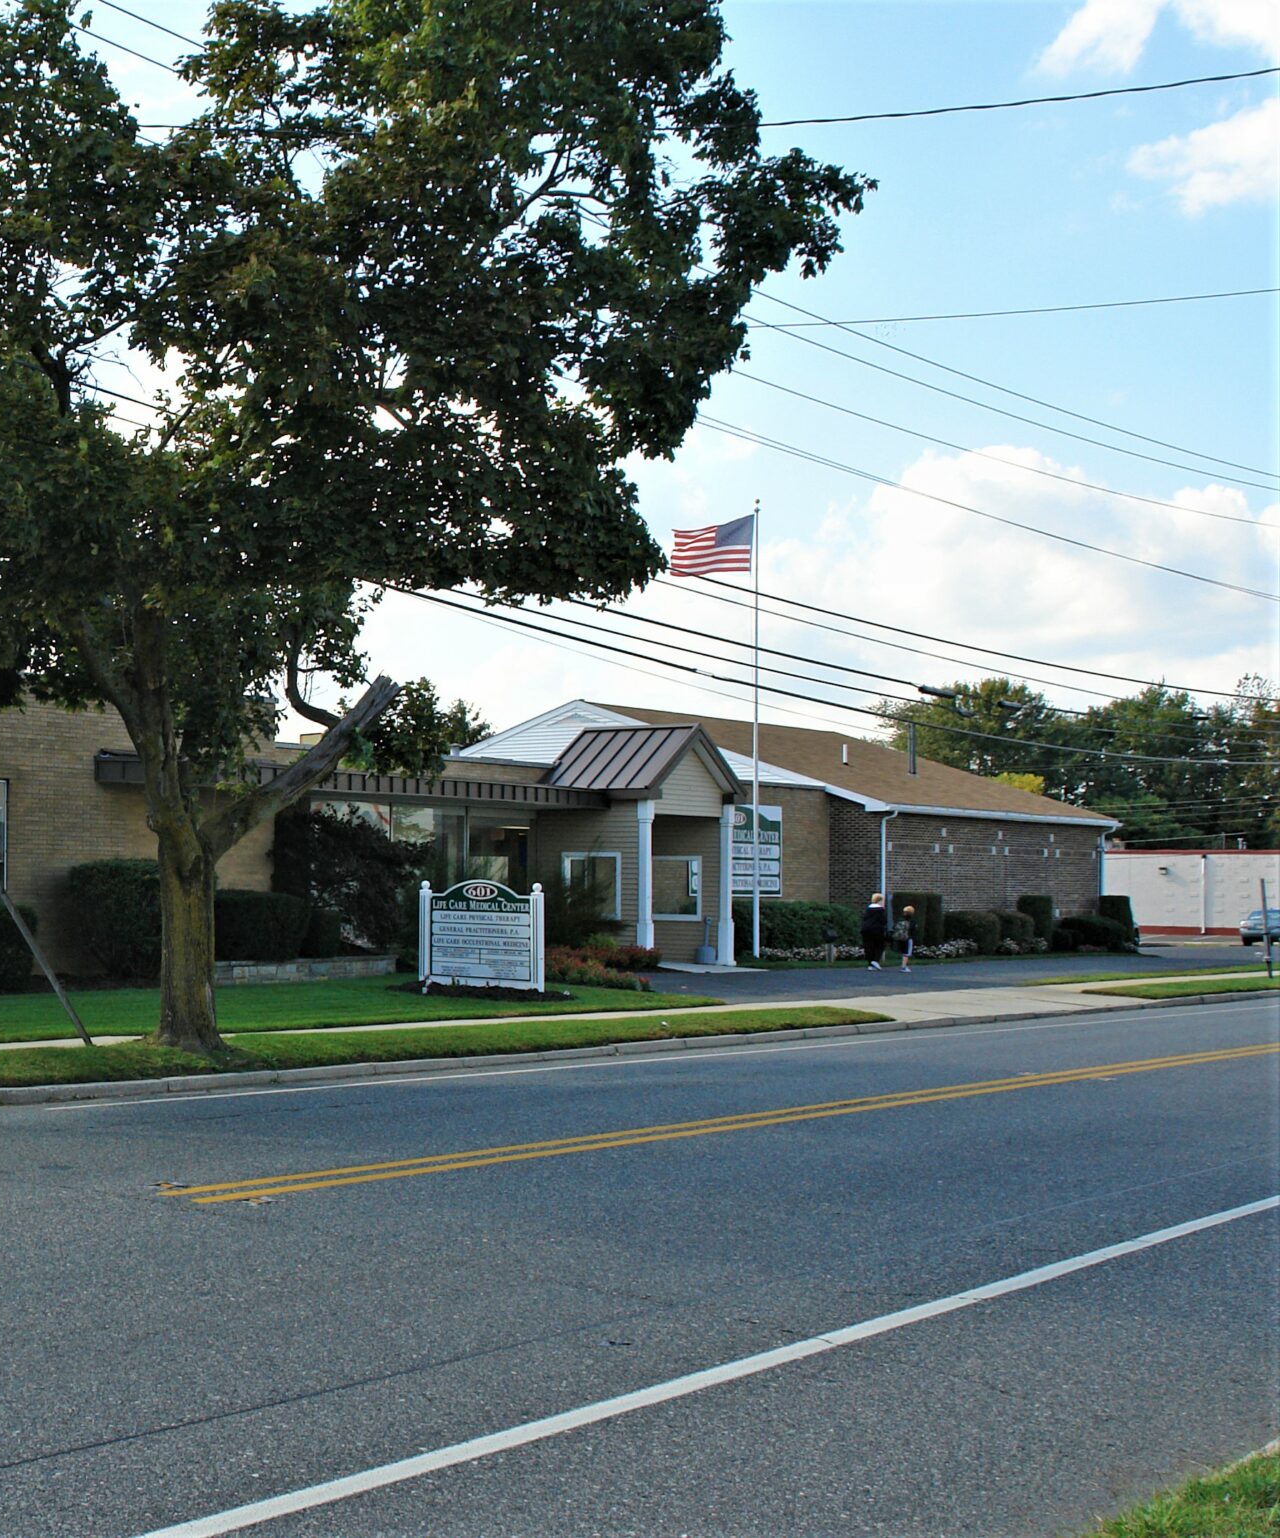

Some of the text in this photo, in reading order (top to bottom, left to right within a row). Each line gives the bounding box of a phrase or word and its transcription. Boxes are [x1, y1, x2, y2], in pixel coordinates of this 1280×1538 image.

[468, 886, 491, 896] 601
[432, 900, 530, 912] LIFE CARE MEDICAL CENTER
